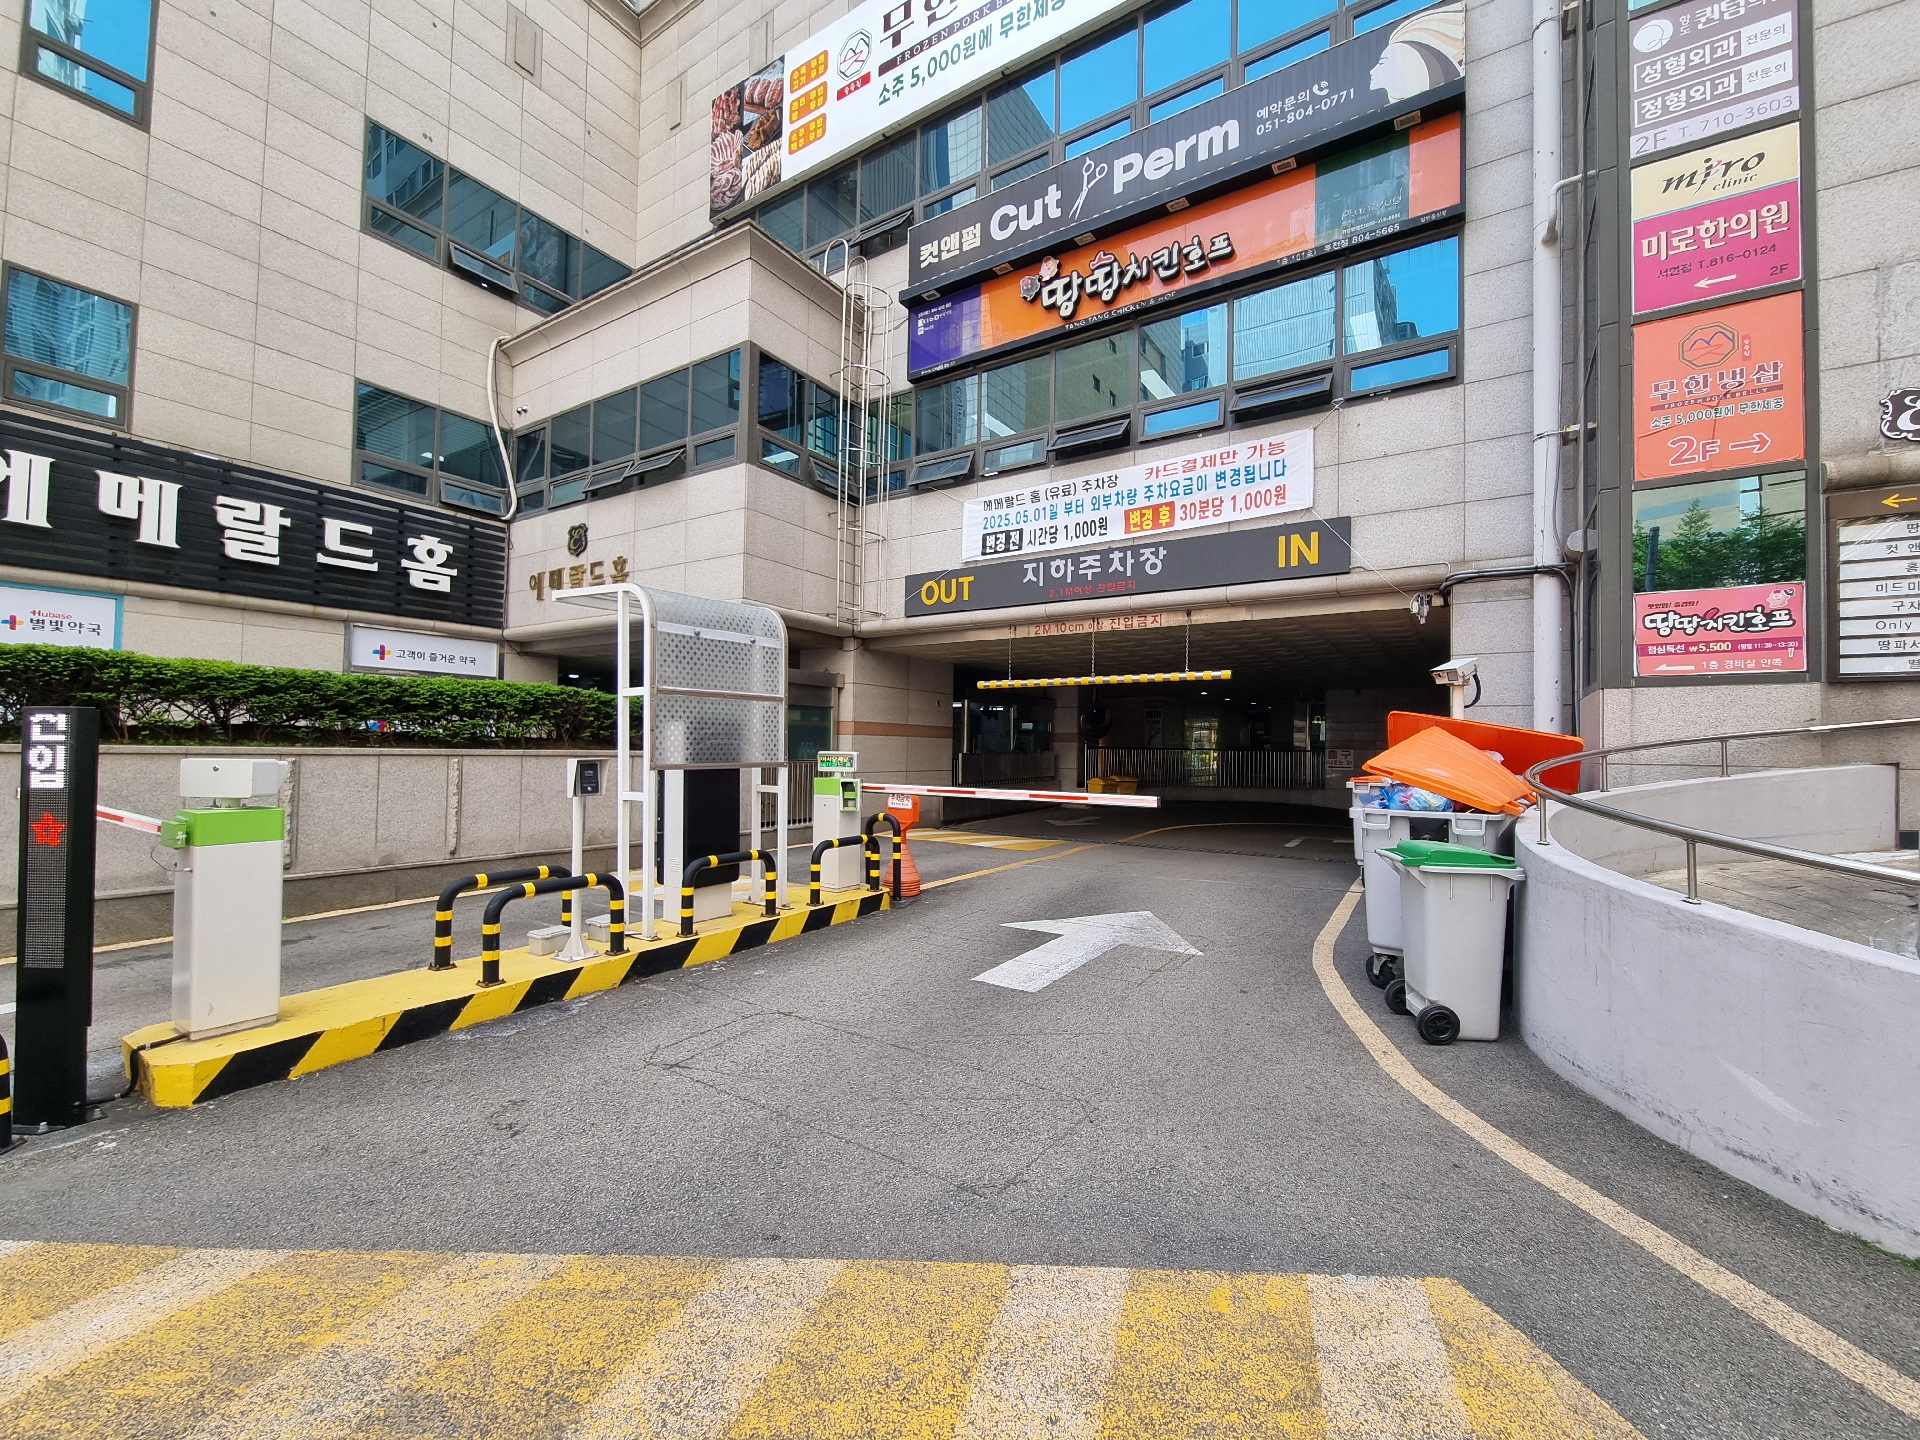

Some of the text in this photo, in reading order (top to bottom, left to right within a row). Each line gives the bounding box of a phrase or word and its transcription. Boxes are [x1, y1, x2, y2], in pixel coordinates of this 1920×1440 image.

[896, 28, 949, 66] FROZEN
[954, 4, 990, 34] PORK
[879, 73, 904, 106] 소주
[910, 23, 992, 88] 5,000원에
[1640, 23, 1786, 84] 성형외과 전문의
[1256, 90, 1310, 119] 예약문의
[1641, 62, 1787, 120] 정형외과 전문의
[1256, 88, 1355, 136] 051-804-0771
[1635, 130, 1668, 155] 2F
[1700, 95, 1793, 132] 710-3603
[920, 119, 1240, 269] 컷앤펌 Cut Perm
[1712, 173, 1758, 192] clinic
[1352, 223, 1400, 244] 804-5665
[1641, 200, 1790, 261] 미로한의원
[1041, 232, 1235, 320] 땅땅치킨호프
[1657, 260, 1692, 279] 서면점
[1770, 263, 1789, 276] 2F
[1065, 318, 1085, 330] TANG
[1088, 311, 1110, 324] TANG
[1111, 301, 1147, 317] CHICKEN
[1650, 360, 1783, 402] 무한냉삼
[1650, 396, 1784, 429] 소주 5,000원에 무한제공
[1664, 398, 1703, 409] FROZEN
[1735, 387, 1768, 397] BELLY
[1144, 441, 1286, 481] 카드결제만 가능
[1667, 435, 1720, 466] 2F
[983, 474, 1119, 512] 에메랄드 홈 (유료) 주차장
[983, 458, 1287, 530] 2025.05.01일 부터 외부차량 주차요금이 변경됩니다
[0, 448, 458, 593] 에메랄드홈
[985, 484, 1287, 553] 변경 전 시간당 1,000원 변경 후 30분당 1,000원
[1278, 531, 1319, 568] IN
[529, 555, 630, 601] 에메랄드홈
[1022, 546, 1168, 587] 지하주차장
[920, 575, 975, 606] OUT
[1049, 580, 1137, 597] 2.1M이상 진입금지
[29, 617, 103, 636] 별빛약국
[30, 609, 73, 620] Hubase
[1109, 614, 1163, 630] 진입금지
[1644, 605, 1793, 636] 땅땅치킨호프
[1875, 619, 1912, 631] Only
[396, 649, 477, 666] 고객이 즐거운 약국
[1647, 643, 1685, 655] 점심특선
[1701, 657, 1783, 670] 1층 경비실 안쪽
